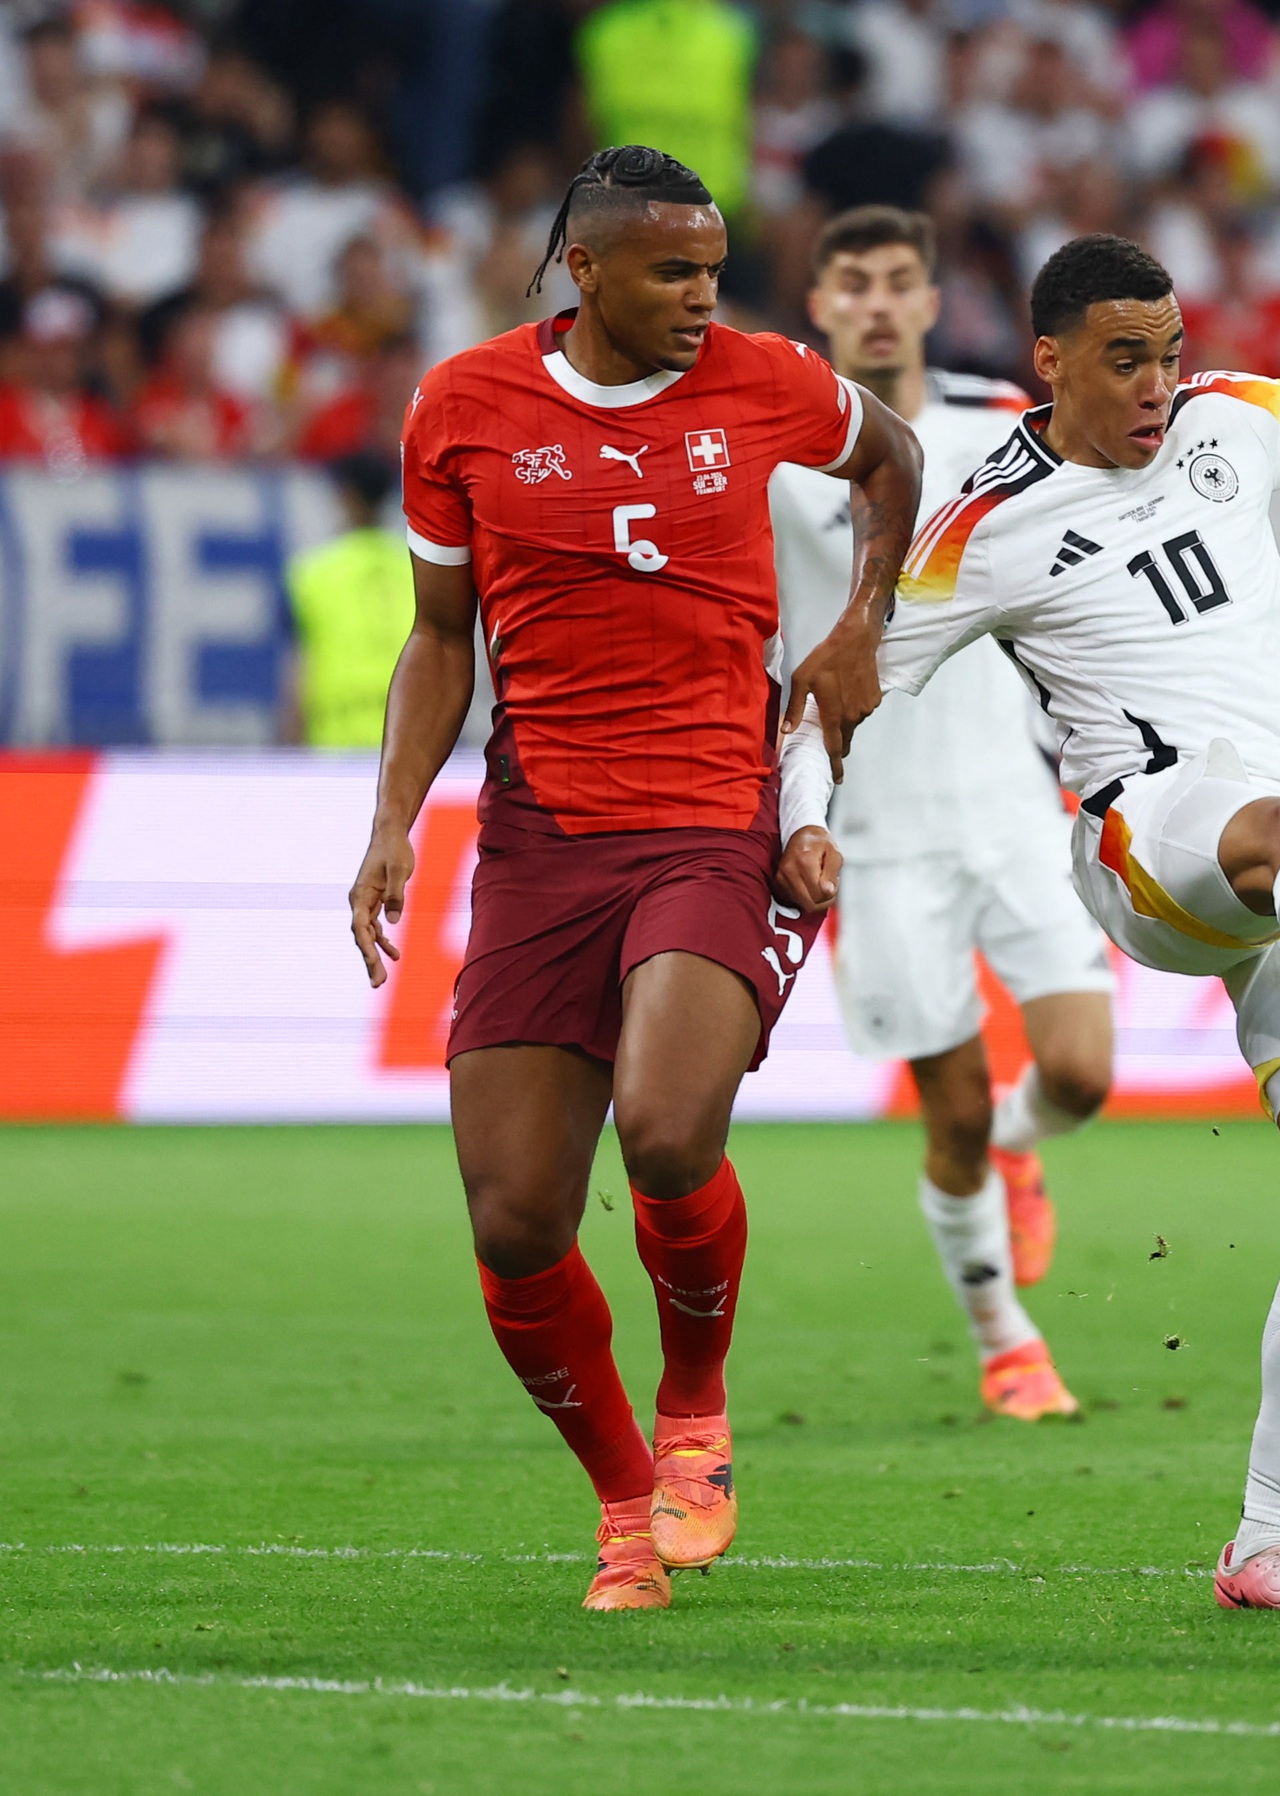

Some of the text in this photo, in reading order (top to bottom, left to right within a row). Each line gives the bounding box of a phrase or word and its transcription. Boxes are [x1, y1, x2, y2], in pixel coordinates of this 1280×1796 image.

[612, 502, 670, 573] 5
[1126, 529, 1234, 626] 10
[767, 895, 804, 965] 5
[517, 1365, 570, 1387] UISSE
